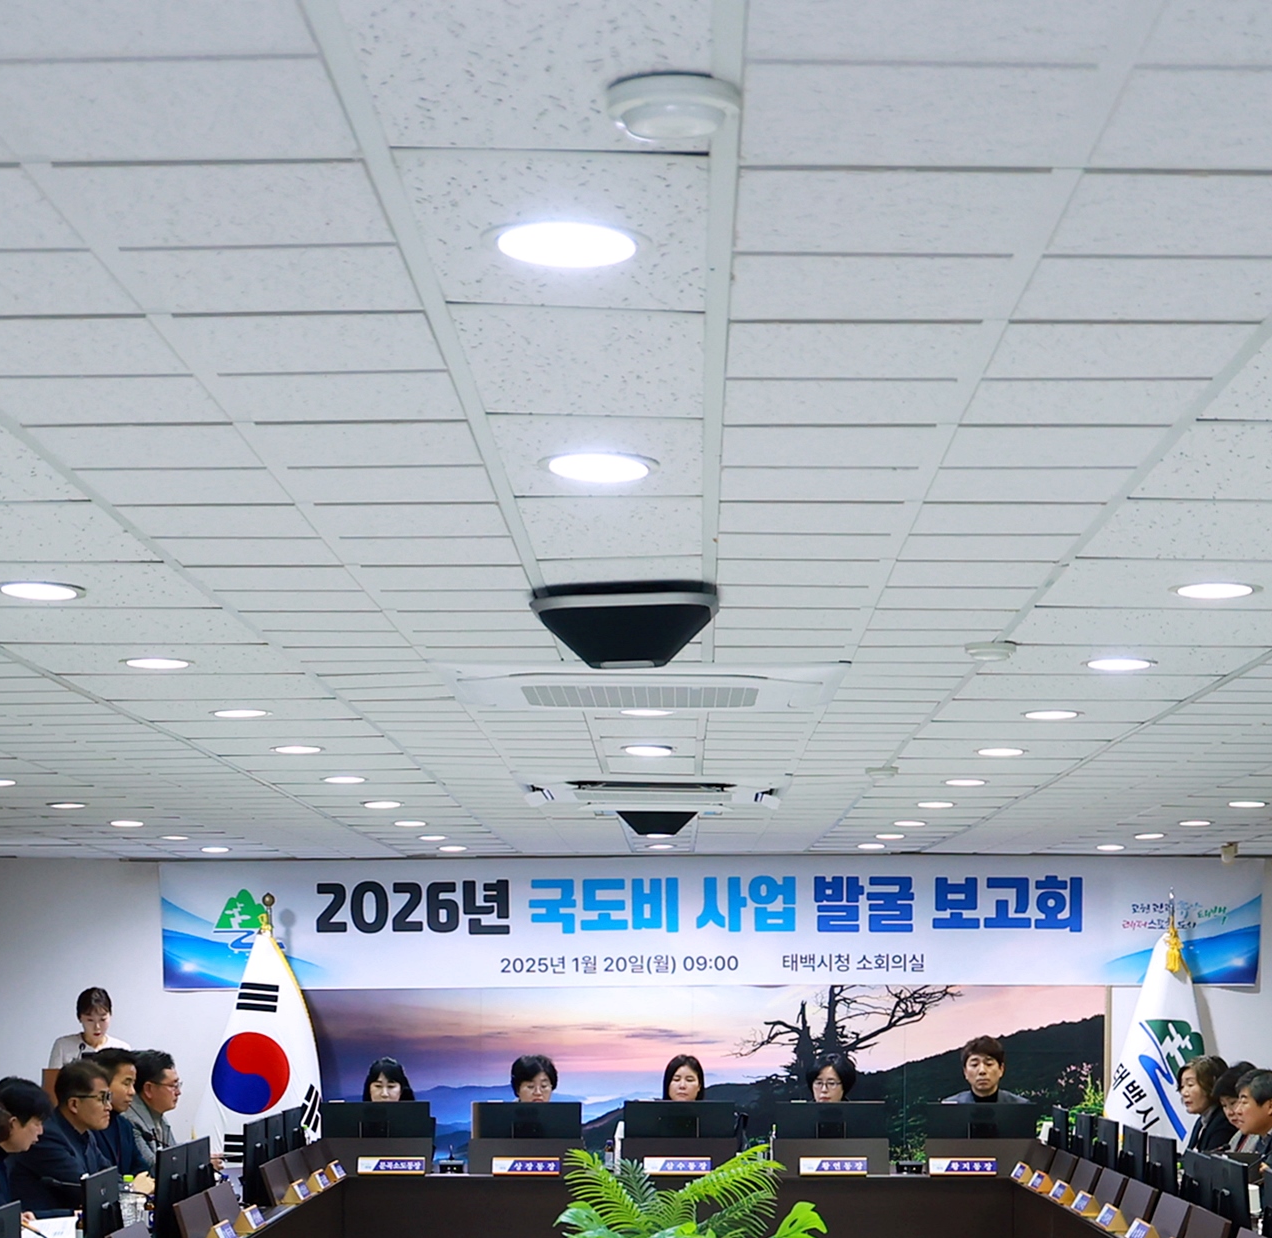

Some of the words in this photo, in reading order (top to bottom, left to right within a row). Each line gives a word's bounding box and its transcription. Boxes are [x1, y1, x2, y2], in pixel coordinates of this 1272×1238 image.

[315, 878, 511, 935] 2026년
[526, 877, 680, 934] 국도비
[695, 874, 798, 933] 사업
[813, 875, 915, 933] 발굴
[931, 874, 1084, 933] 보고회
[499, 956, 567, 975] 2025년
[574, 955, 598, 974] 1월
[603, 955, 677, 975] 20일(월)
[682, 955, 739, 972] 09:00
[782, 953, 851, 972] 태백시청
[855, 952, 926, 972] 소회의실
[1112, 1062, 1161, 1131] 태백시
